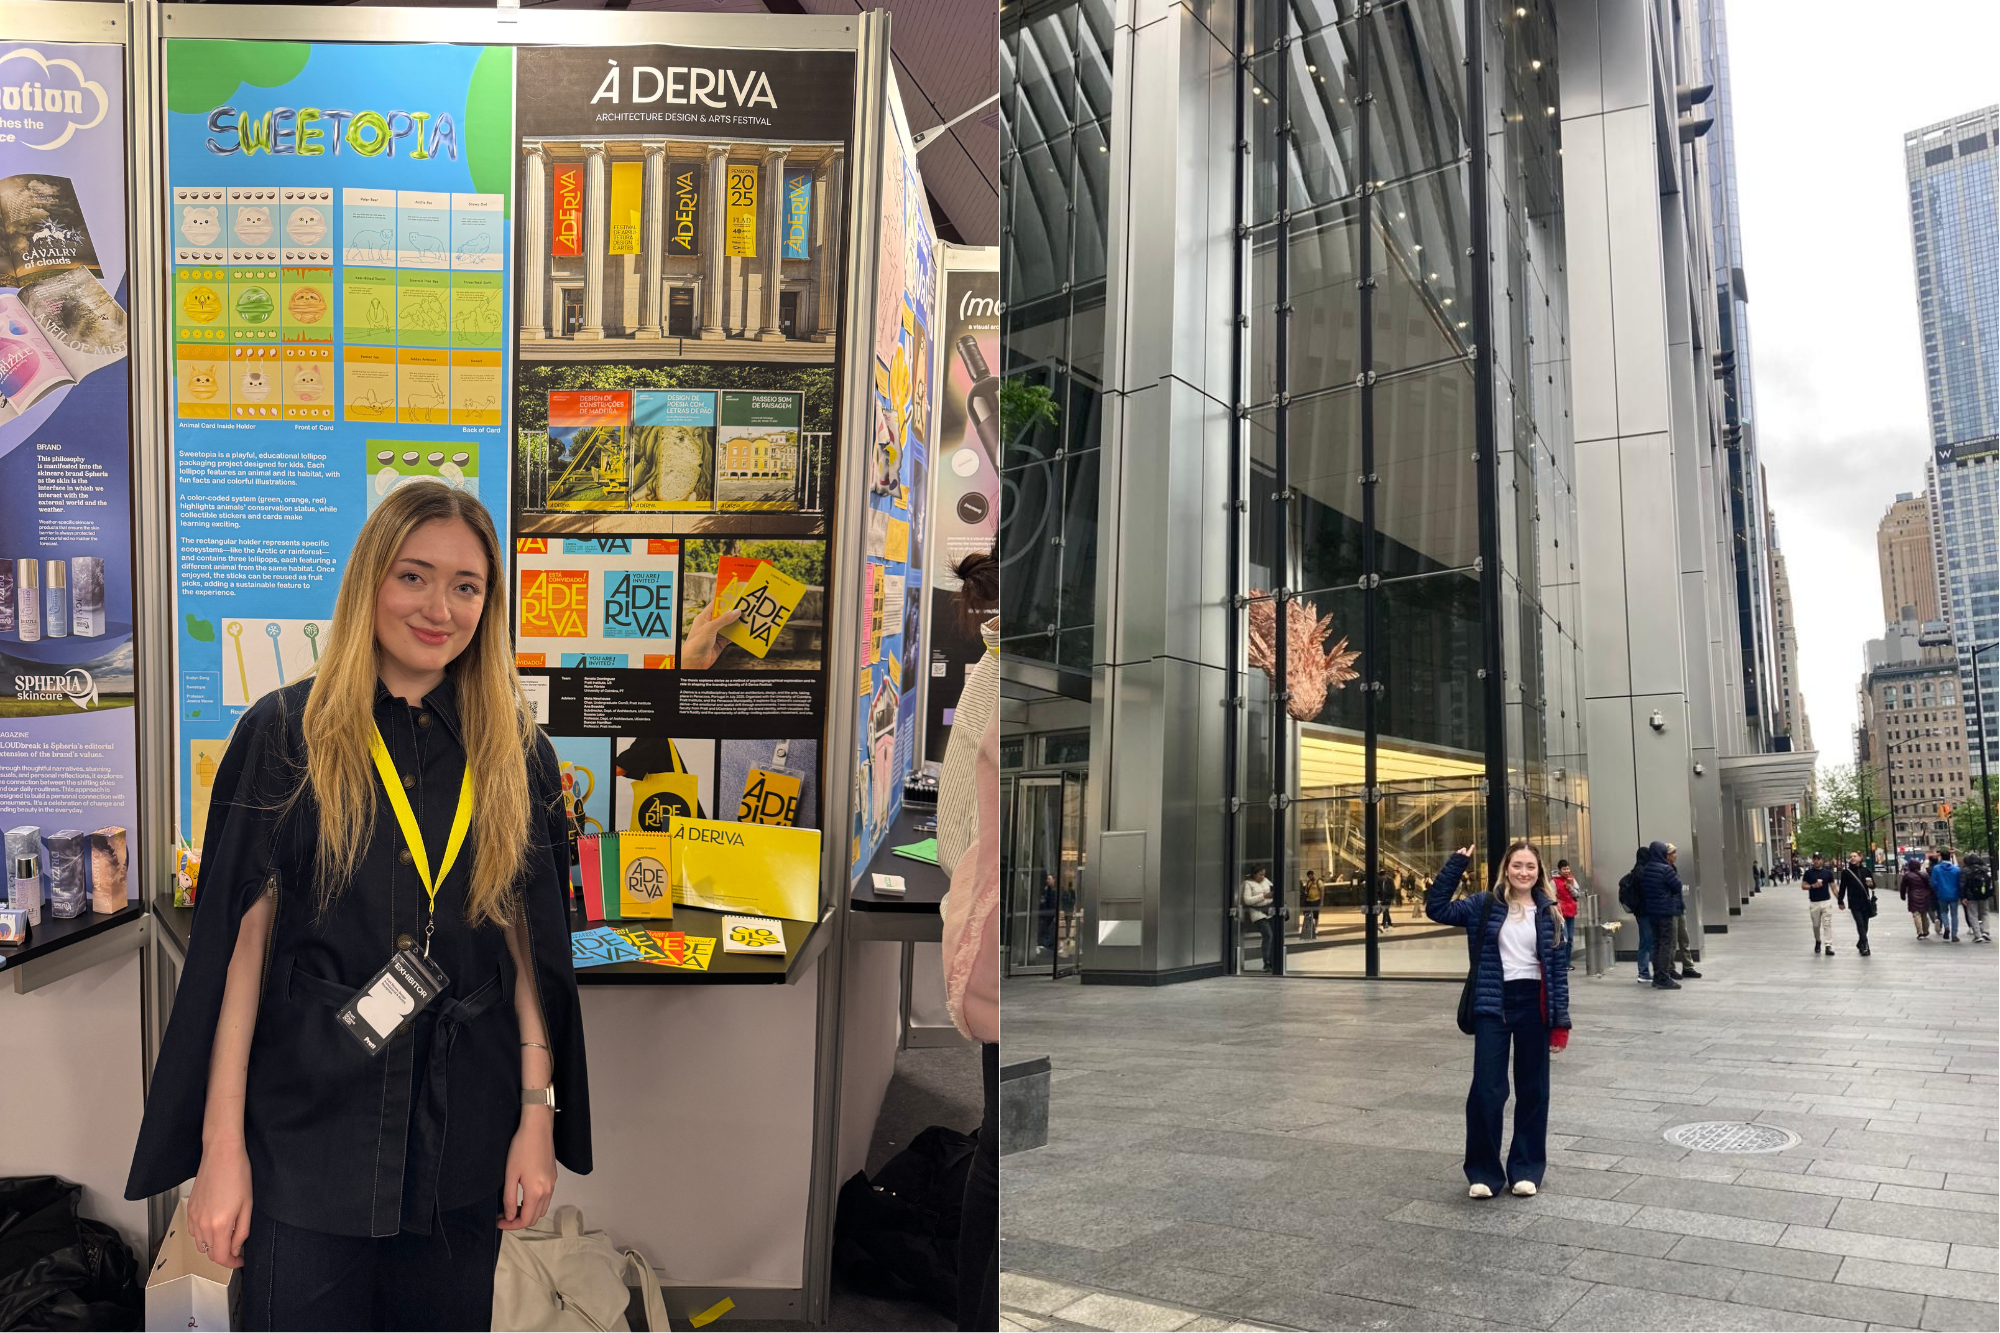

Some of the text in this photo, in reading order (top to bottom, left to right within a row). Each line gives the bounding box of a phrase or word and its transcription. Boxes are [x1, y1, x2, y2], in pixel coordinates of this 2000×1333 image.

[590, 59, 778, 108] À DERIVA
[0, 82, 82, 114] otion
[24, 118, 44, 130] the
[596, 113, 663, 121] ARCHITECTURE
[665, 113, 697, 122] DESIGN
[708, 115, 731, 123] ARTS
[733, 116, 771, 125] FESTIVAL
[205, 106, 458, 160] SWEETOPIA
[731, 175, 754, 190] 20
[731, 191, 753, 206] 25
[25, 257, 71, 269] of clouds
[52, 456, 85, 464] philosophy
[179, 450, 216, 460] Sweetopia
[232, 451, 257, 460] playful,
[301, 452, 327, 461] lollipop
[1939, 449, 1951, 459] W
[179, 459, 216, 468] packaging
[217, 460, 243, 469] project
[244, 460, 276, 470] designed
[179, 468, 205, 477] lollipop
[297, 470, 323, 479] habitat,
[15, 675, 82, 691] SPHERIA
[17, 691, 62, 700] skincare
[50, 742, 84, 751] Spheria's
[674, 824, 744, 846] À DERIVA
[51, 851, 61, 893] DRIZZLE
[394, 962, 428, 998] EXHIBITOR
[188, 1317, 198, 1328] 2
